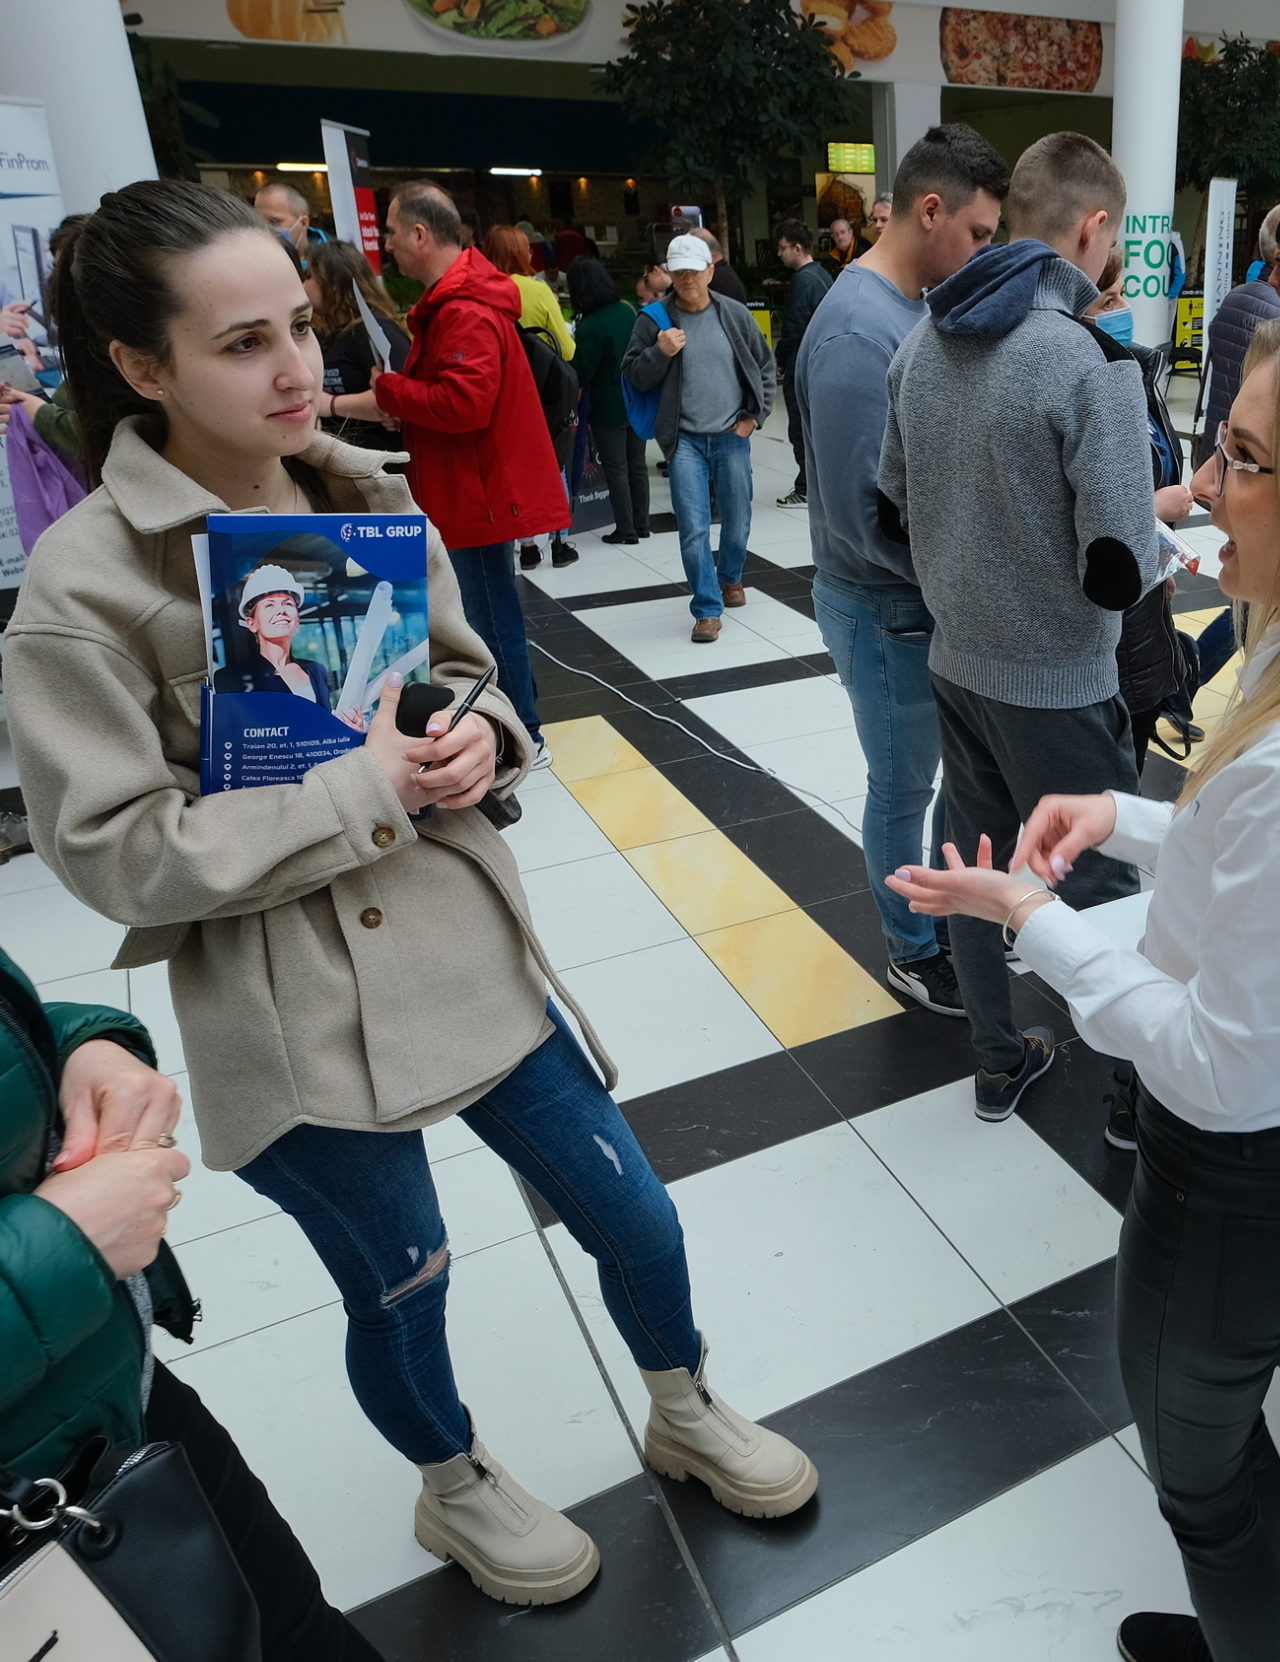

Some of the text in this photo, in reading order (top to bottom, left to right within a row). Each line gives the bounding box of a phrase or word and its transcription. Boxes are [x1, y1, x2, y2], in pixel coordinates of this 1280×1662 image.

[357, 525, 422, 539] TBL GRUP
[243, 726, 290, 738] CONTACT
[322, 738, 337, 746] Alba
[337, 735, 351, 744] Iulia
